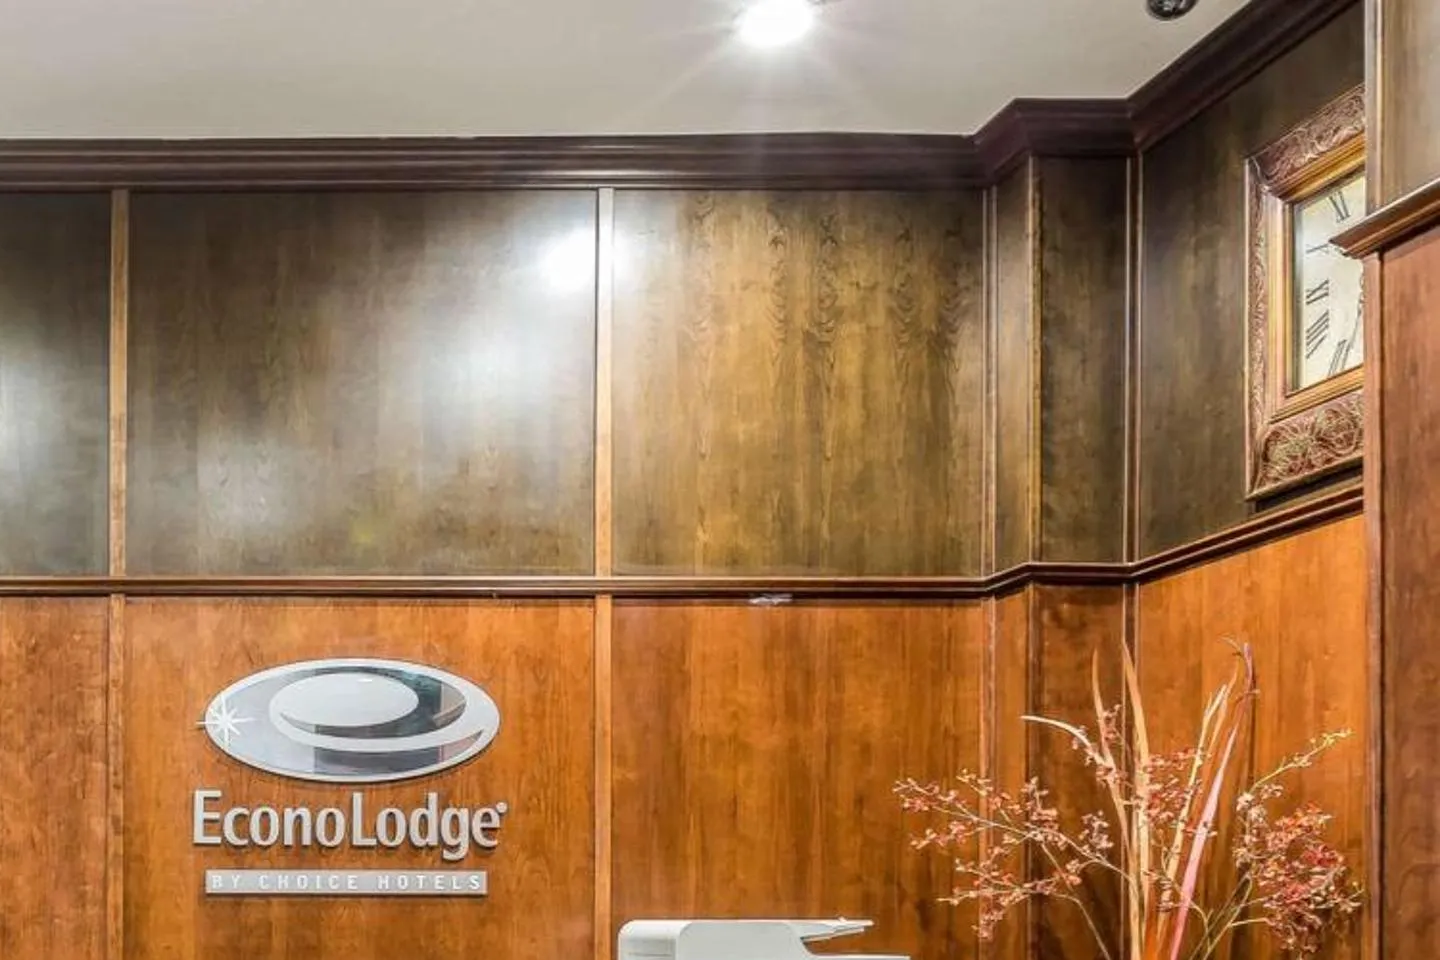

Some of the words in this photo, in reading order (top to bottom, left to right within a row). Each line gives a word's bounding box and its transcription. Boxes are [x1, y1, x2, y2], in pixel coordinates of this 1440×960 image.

[193, 788, 502, 861] EconoLodge
[210, 873, 242, 890] BY
[258, 873, 359, 891] CHOICE
[376, 873, 483, 891] HOTELS
